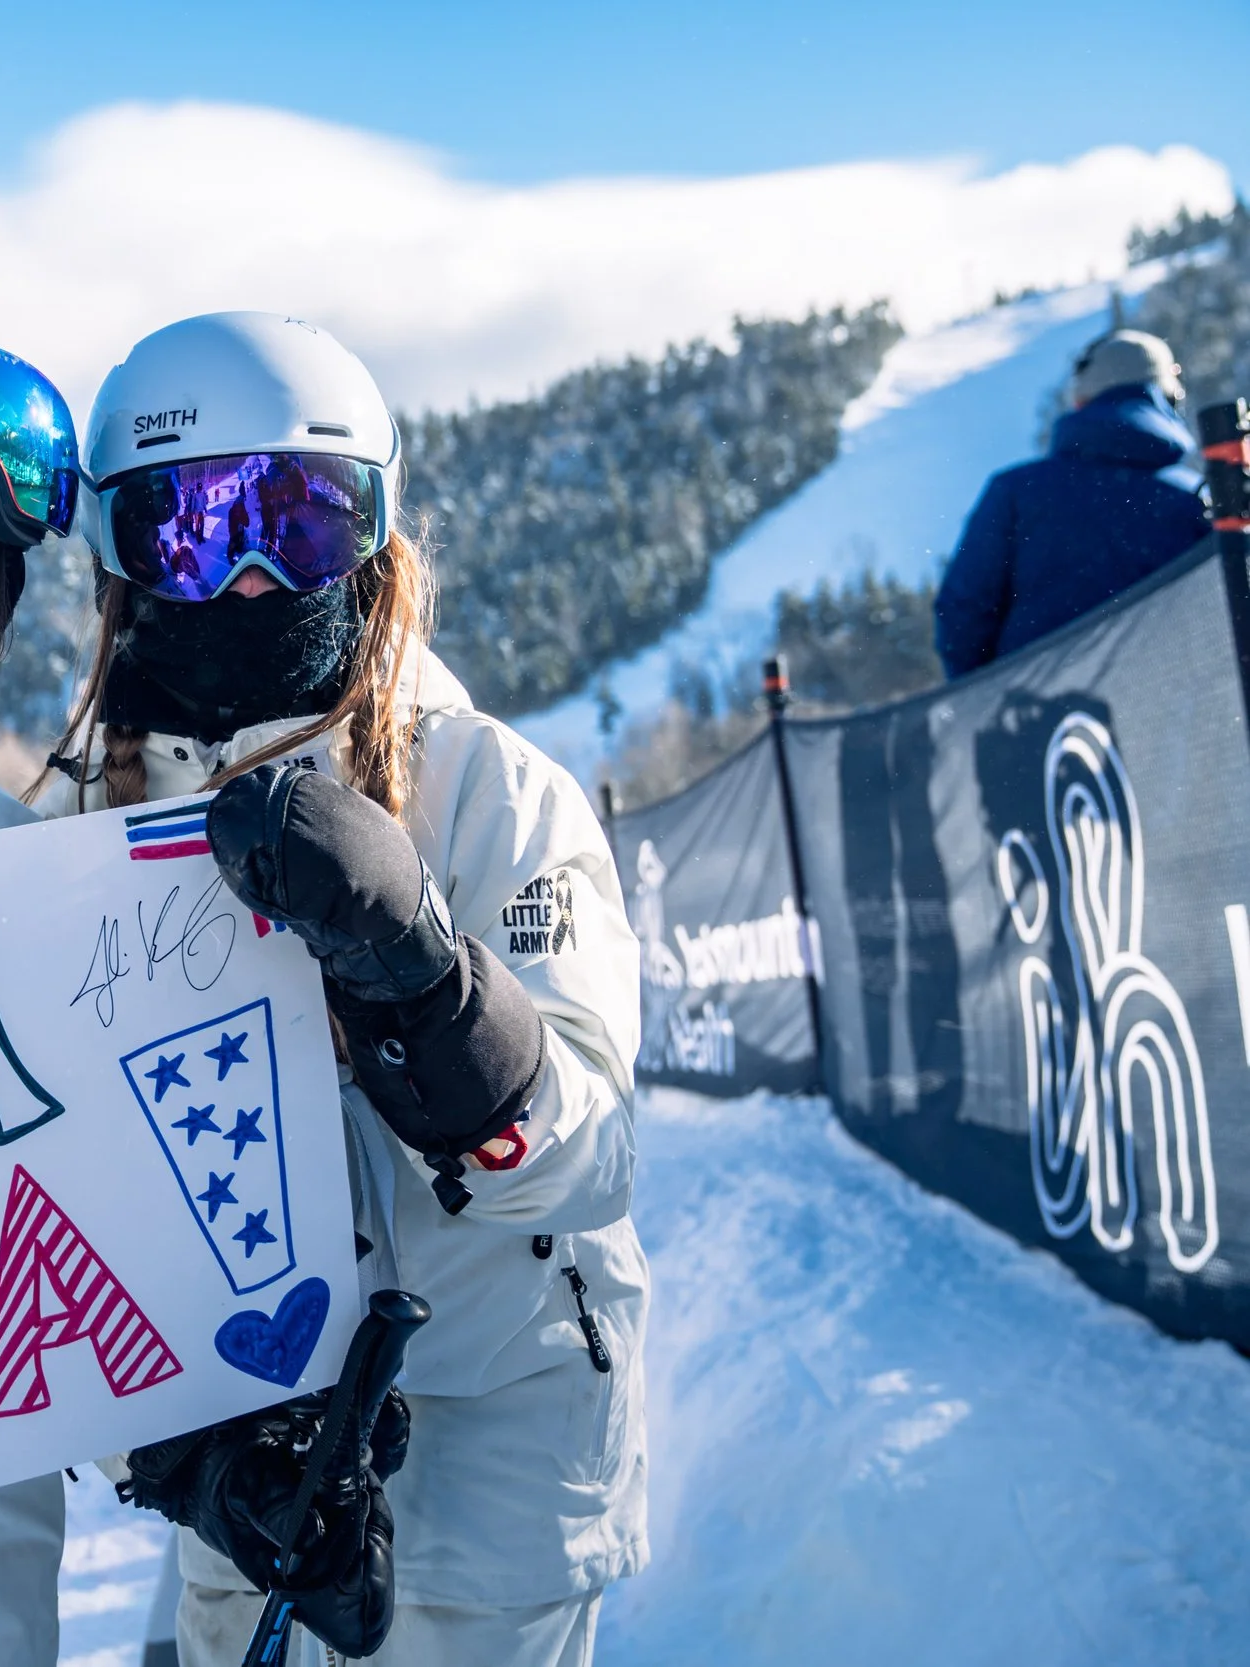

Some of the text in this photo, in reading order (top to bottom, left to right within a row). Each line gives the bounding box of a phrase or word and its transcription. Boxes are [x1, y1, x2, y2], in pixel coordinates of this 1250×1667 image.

[133, 408, 198, 434] SMITH
[502, 904, 552, 927] LITTLE
[509, 931, 551, 954] ARMY
